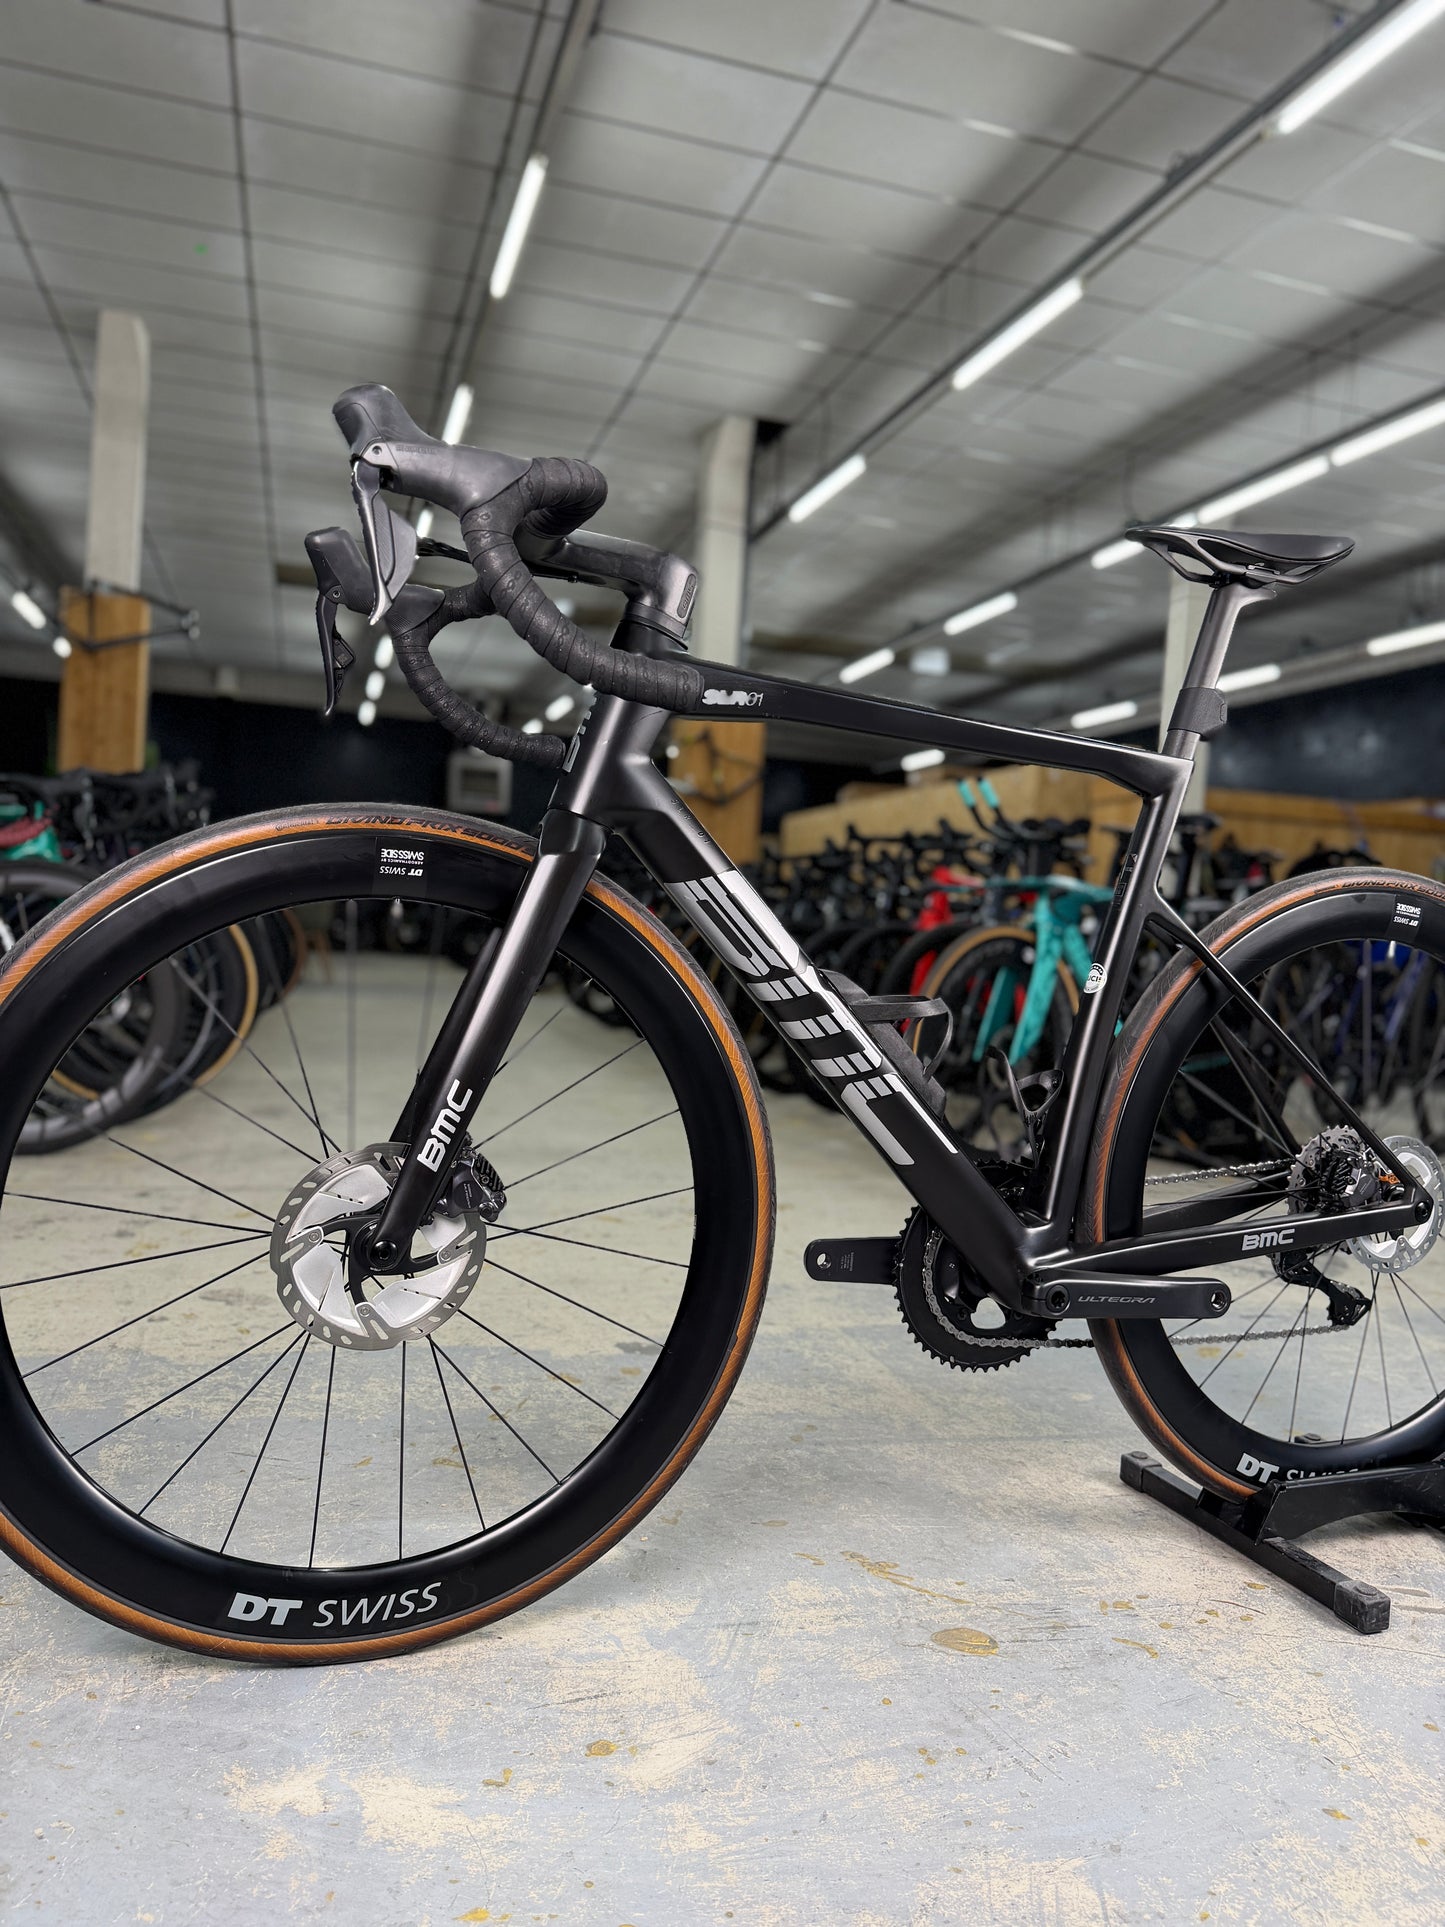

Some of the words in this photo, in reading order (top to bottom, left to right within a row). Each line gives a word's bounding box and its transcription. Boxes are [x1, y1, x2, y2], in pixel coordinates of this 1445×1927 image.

[379, 865, 407, 875] SWISS
[407, 868, 424, 877] DT
[416, 1078, 474, 1173] BMC
[1241, 1228, 1296, 1251] BMC
[1078, 1295, 1157, 1304] ULTEGRA
[1236, 1452, 1280, 1485] DT
[227, 1592, 303, 1626] DT
[312, 1581, 442, 1628] SWISS
